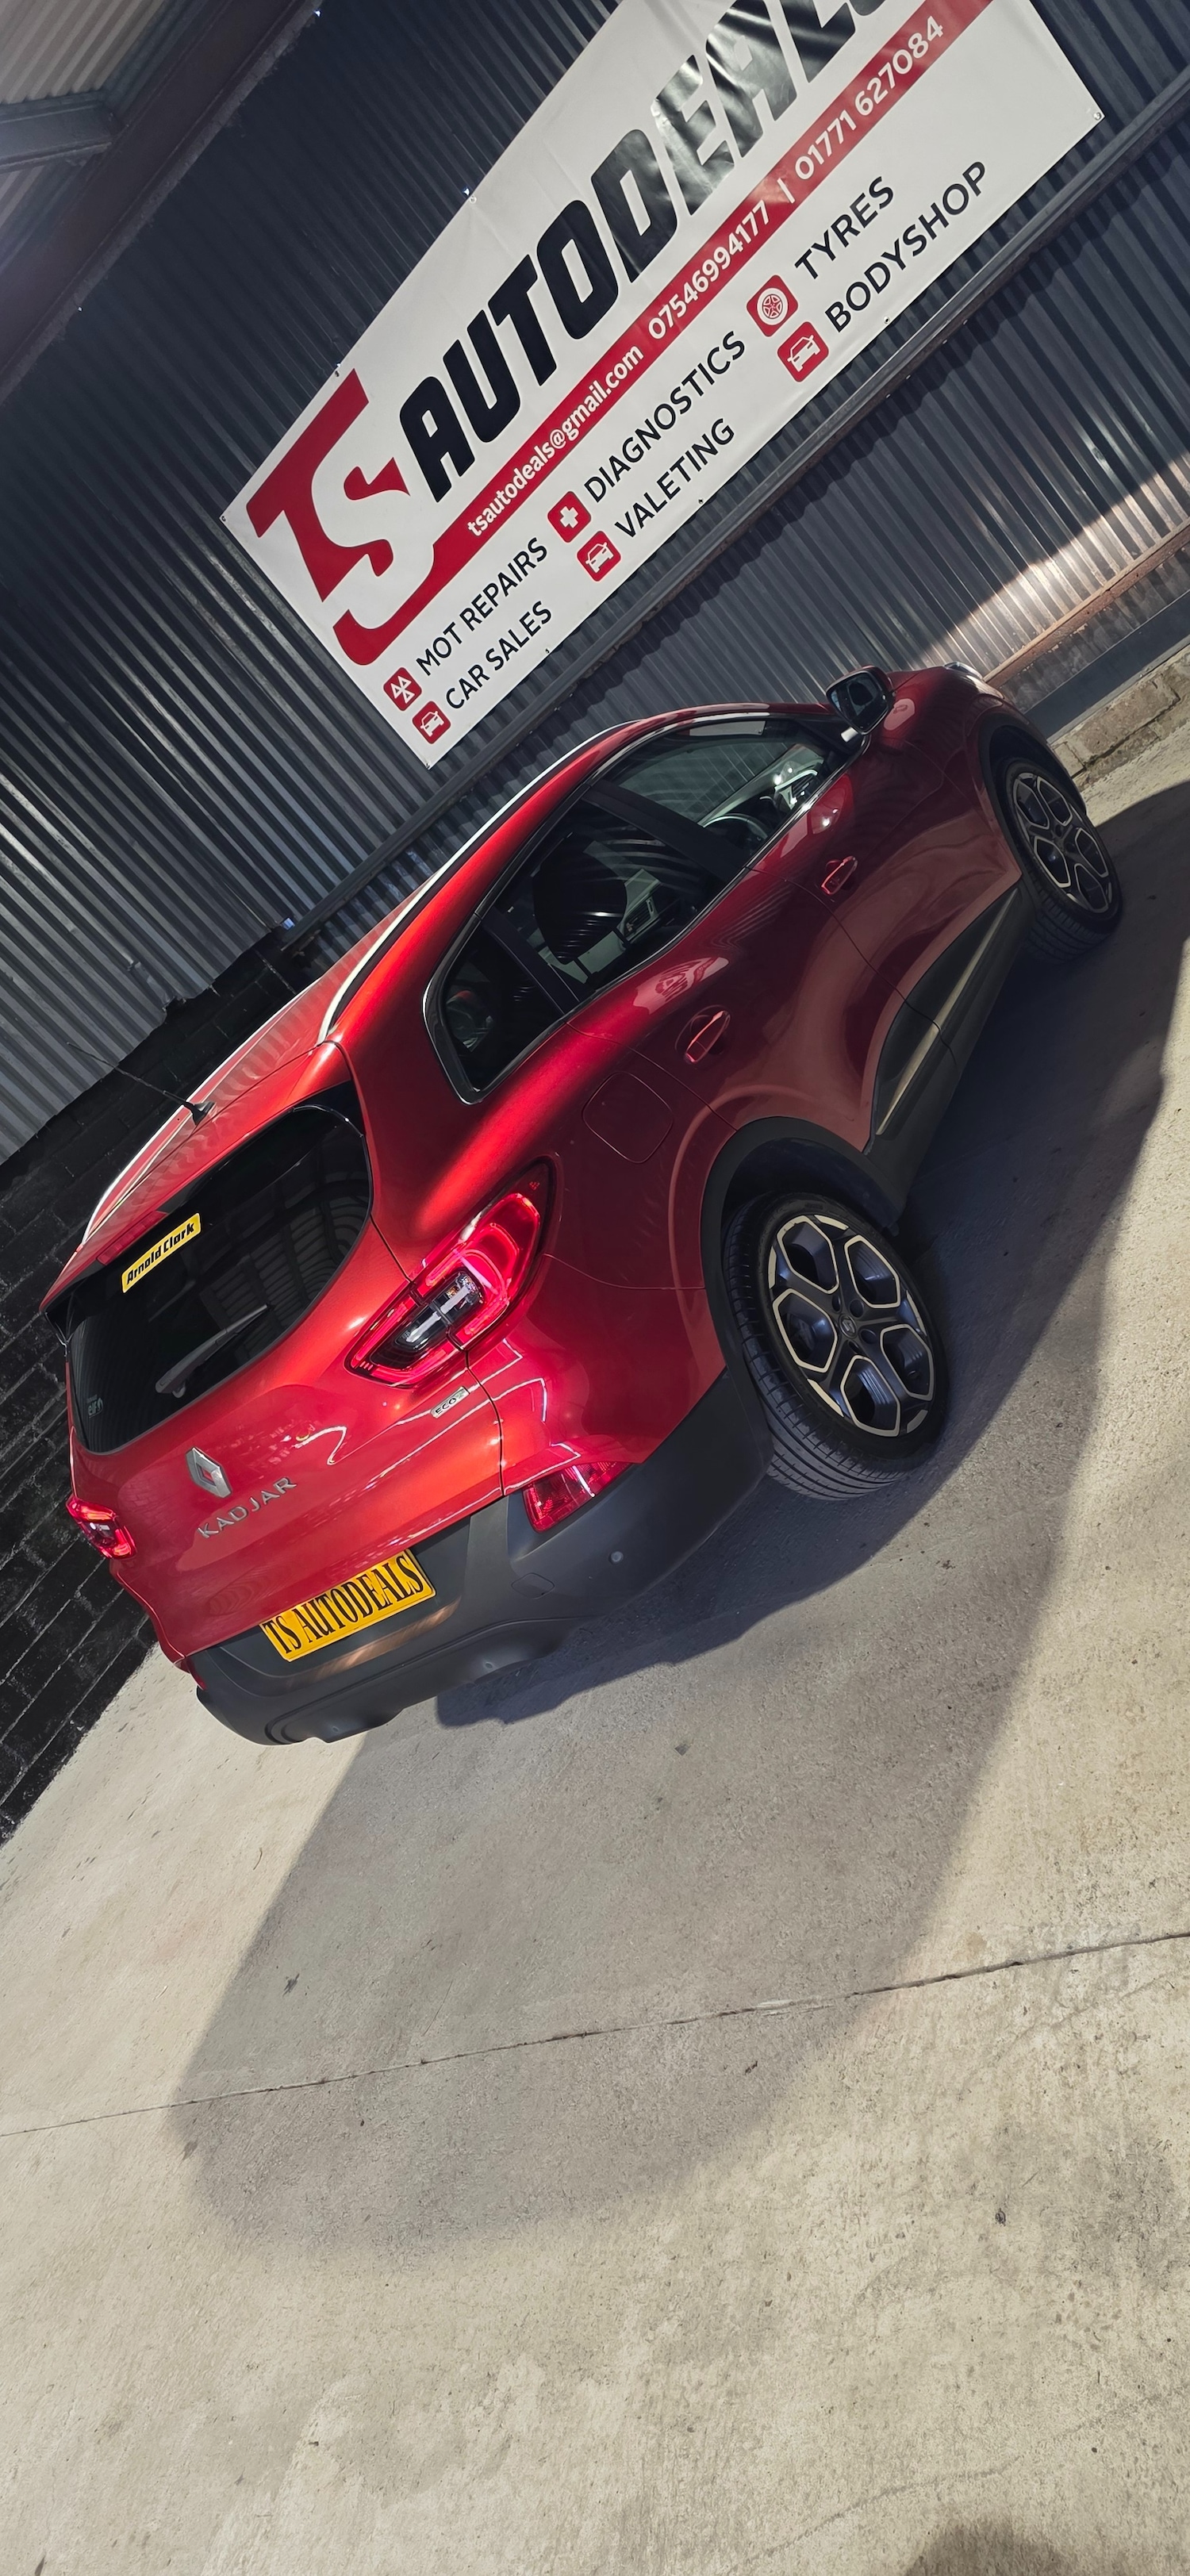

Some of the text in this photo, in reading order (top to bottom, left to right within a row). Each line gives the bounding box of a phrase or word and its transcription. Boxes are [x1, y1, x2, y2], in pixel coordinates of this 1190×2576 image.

[467, 345, 643, 536] tsautodeals@gmail.com
[648, 200, 770, 340] 07546994177
[795, 110, 857, 180] 01771
[854, 16, 943, 116] 627084
[794, 176, 894, 280] TYRES
[825, 161, 987, 332] BODYSHOP
[246, 0, 885, 665] TS AUTODEAL
[584, 332, 745, 503] DIAGNOSTICS
[614, 417, 735, 538] VALETING
[416, 537, 547, 676] MOT REPAIRS
[445, 601, 552, 709] CAR SALES
[127, 1223, 194, 1285] Arnold Clark
[198, 1477, 297, 1538] KADJAR
[263, 1554, 424, 1654] TS AUTODEALS
